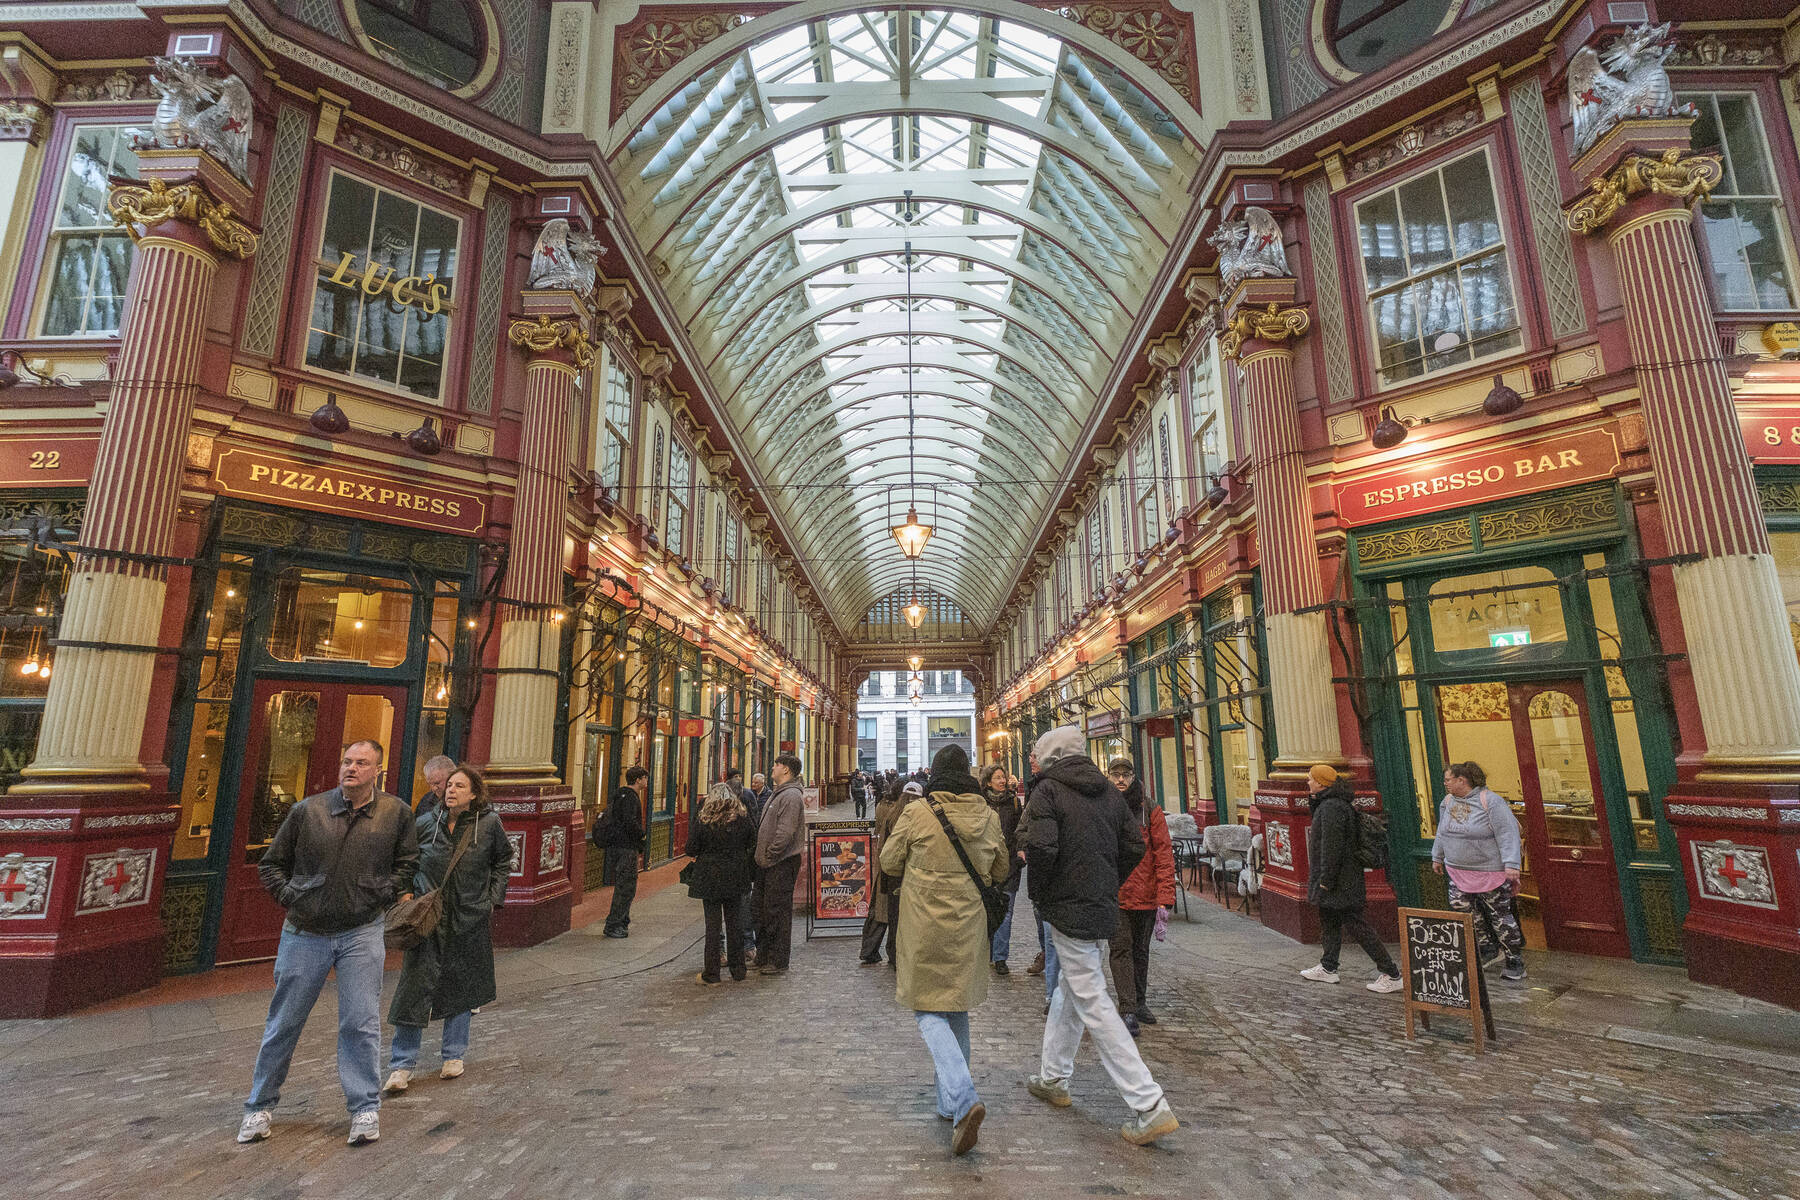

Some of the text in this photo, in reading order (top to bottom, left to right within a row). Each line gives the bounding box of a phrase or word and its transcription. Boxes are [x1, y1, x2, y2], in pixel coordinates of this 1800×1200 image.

[327, 252, 448, 314] LUC'S
[1764, 426, 1782, 445] 8
[29, 451, 60, 469] 22
[249, 463, 461, 518] PIZZAEXPRESS
[1363, 449, 1583, 508] ESPRESSO BAR
[1204, 559, 1228, 584] HAGEN
[1408, 918, 1464, 948] BEST
[1428, 960, 1445, 971] IN
